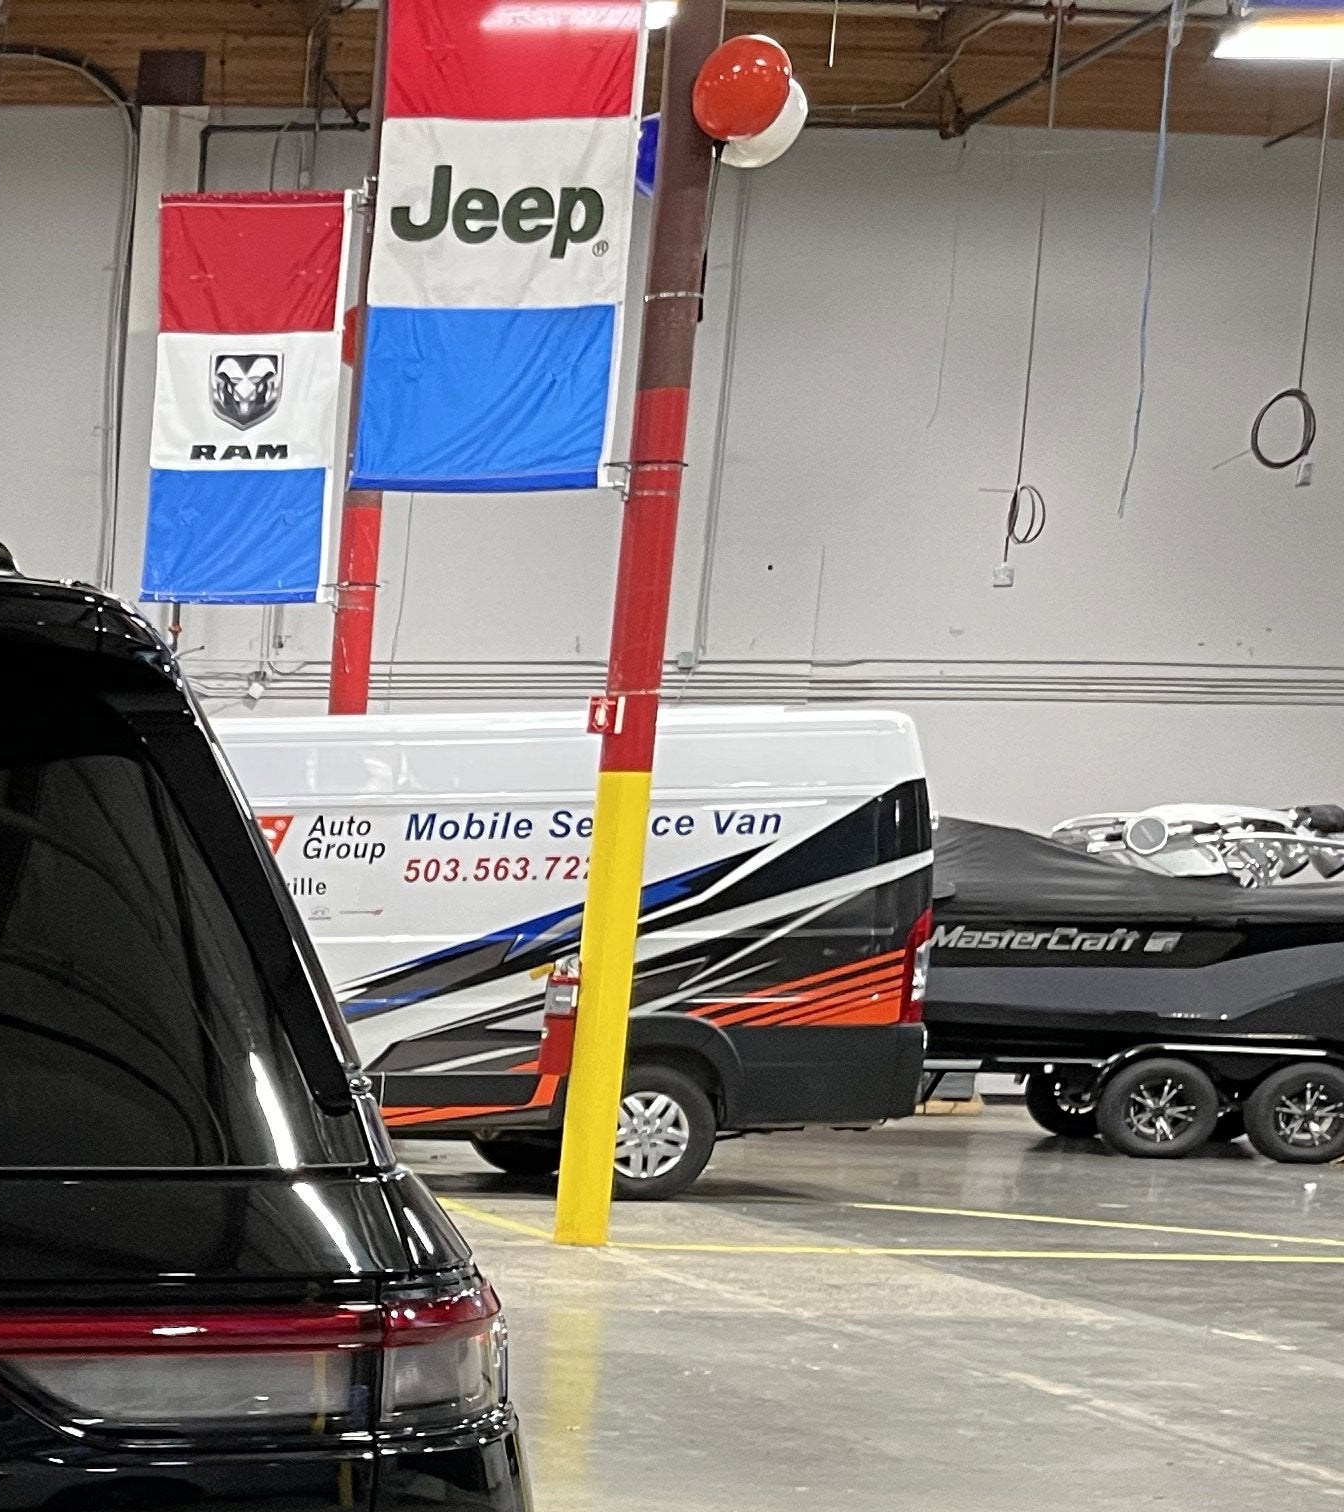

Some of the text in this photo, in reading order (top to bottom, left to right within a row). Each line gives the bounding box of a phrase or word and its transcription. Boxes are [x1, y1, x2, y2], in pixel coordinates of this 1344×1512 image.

[390, 164, 604, 259] Jeep
[190, 444, 288, 461] RAM
[307, 814, 372, 837] Auto
[405, 812, 533, 841] Mobile
[714, 810, 782, 836] Van
[302, 837, 386, 865] Group
[931, 925, 1140, 952] MasterCraft
